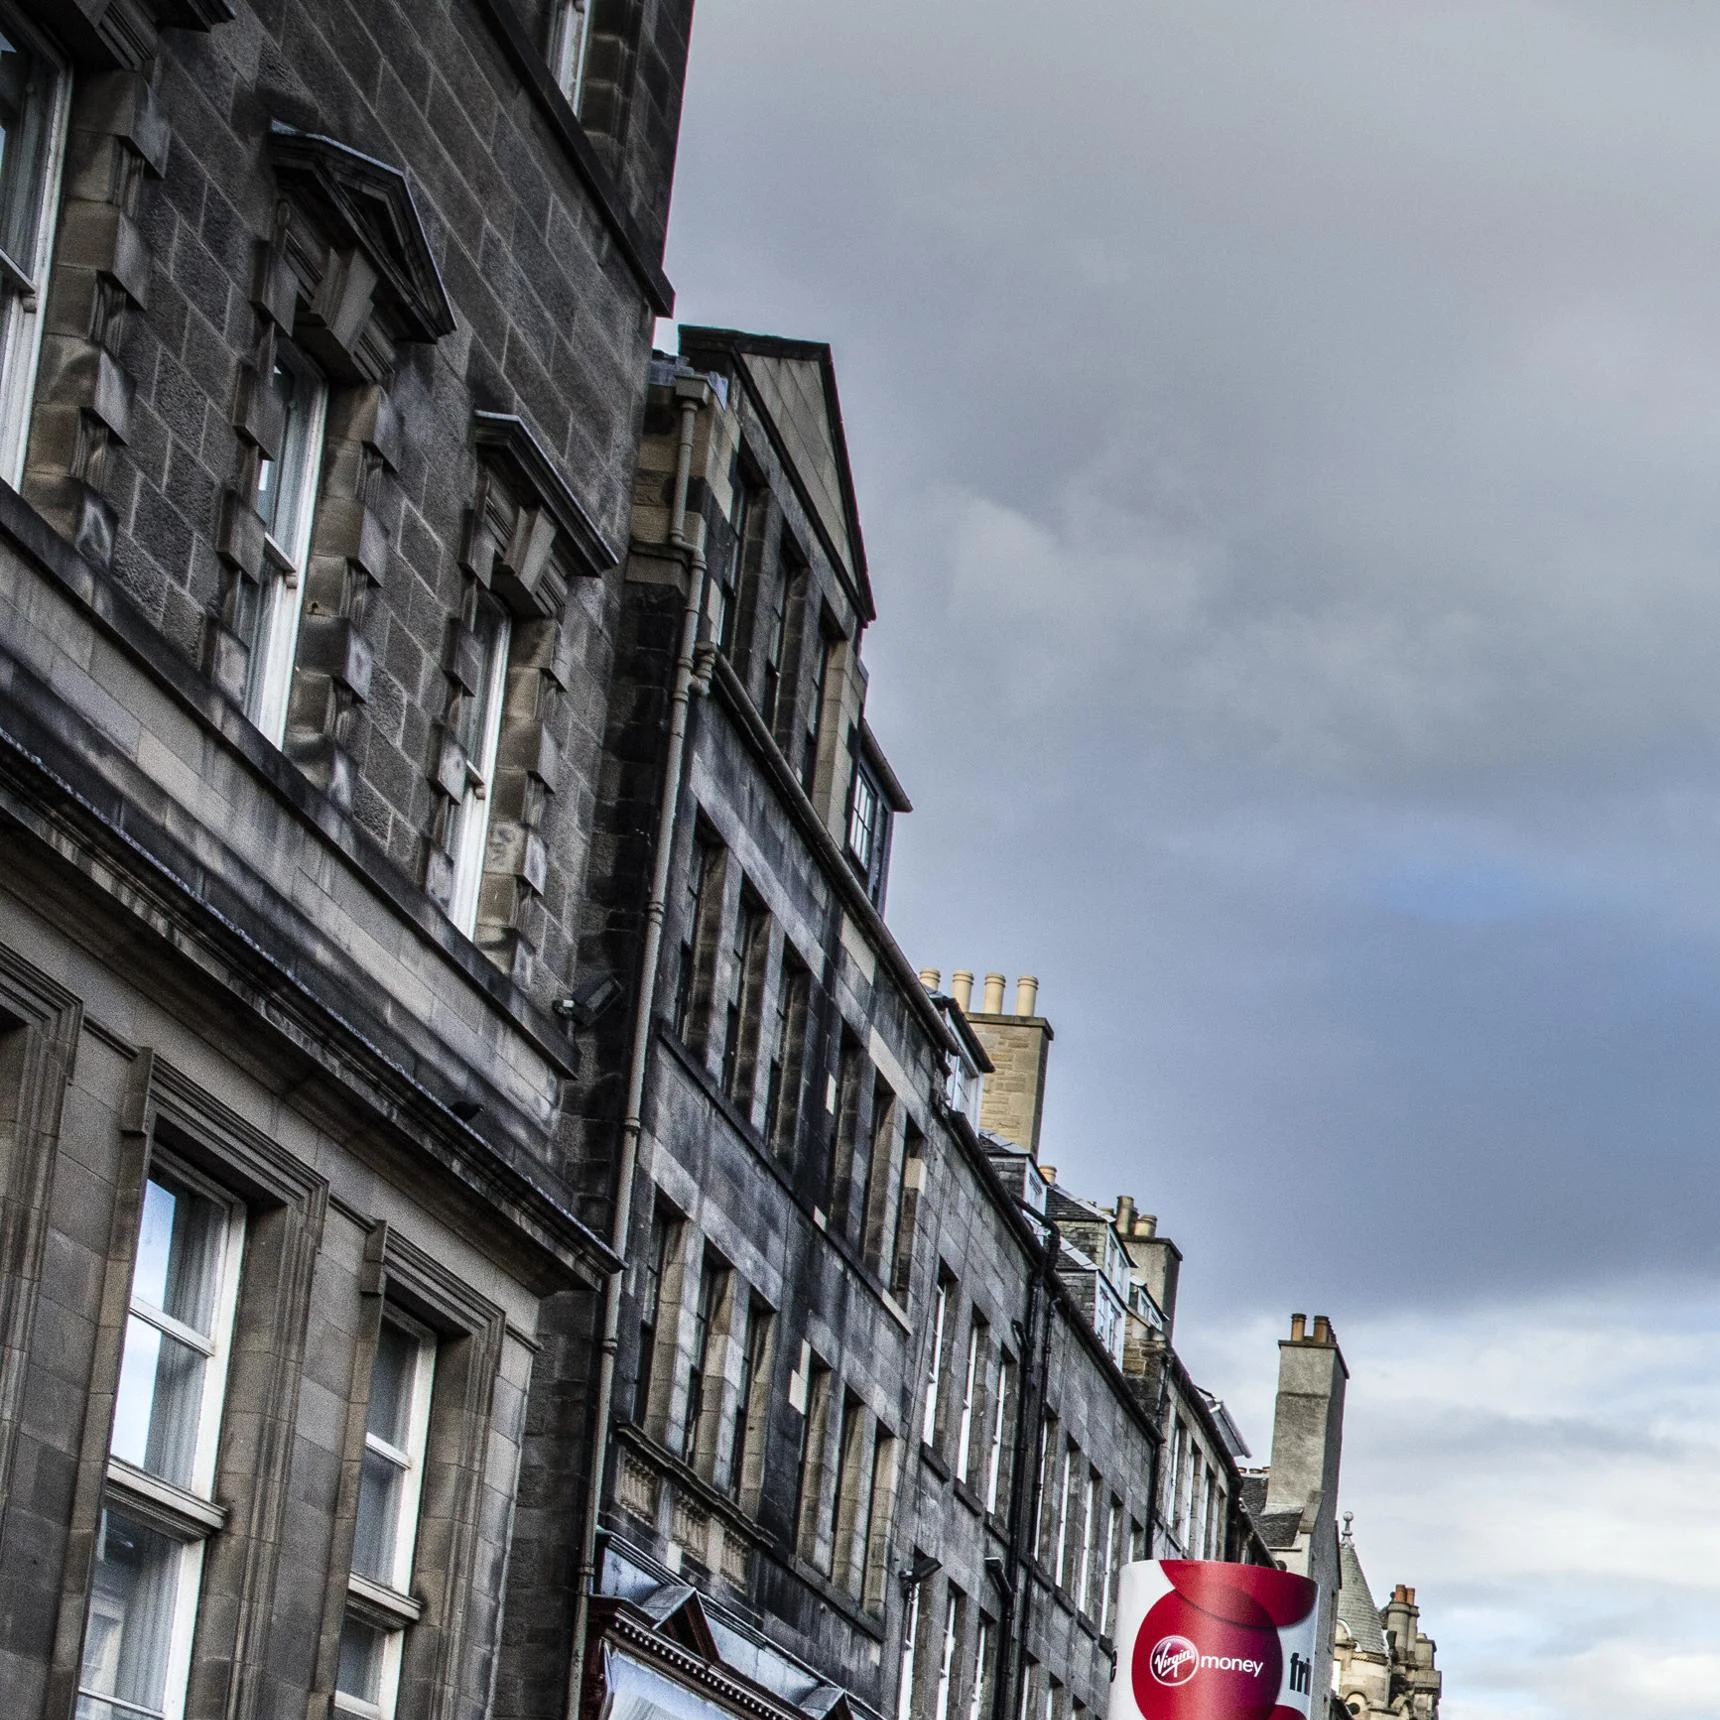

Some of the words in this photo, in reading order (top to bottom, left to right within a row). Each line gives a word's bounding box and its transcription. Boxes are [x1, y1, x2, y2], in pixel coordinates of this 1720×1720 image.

[1154, 1642, 1195, 1678] Virgin
[1200, 1655, 1264, 1678] money
[1290, 1652, 1311, 1697] fri
